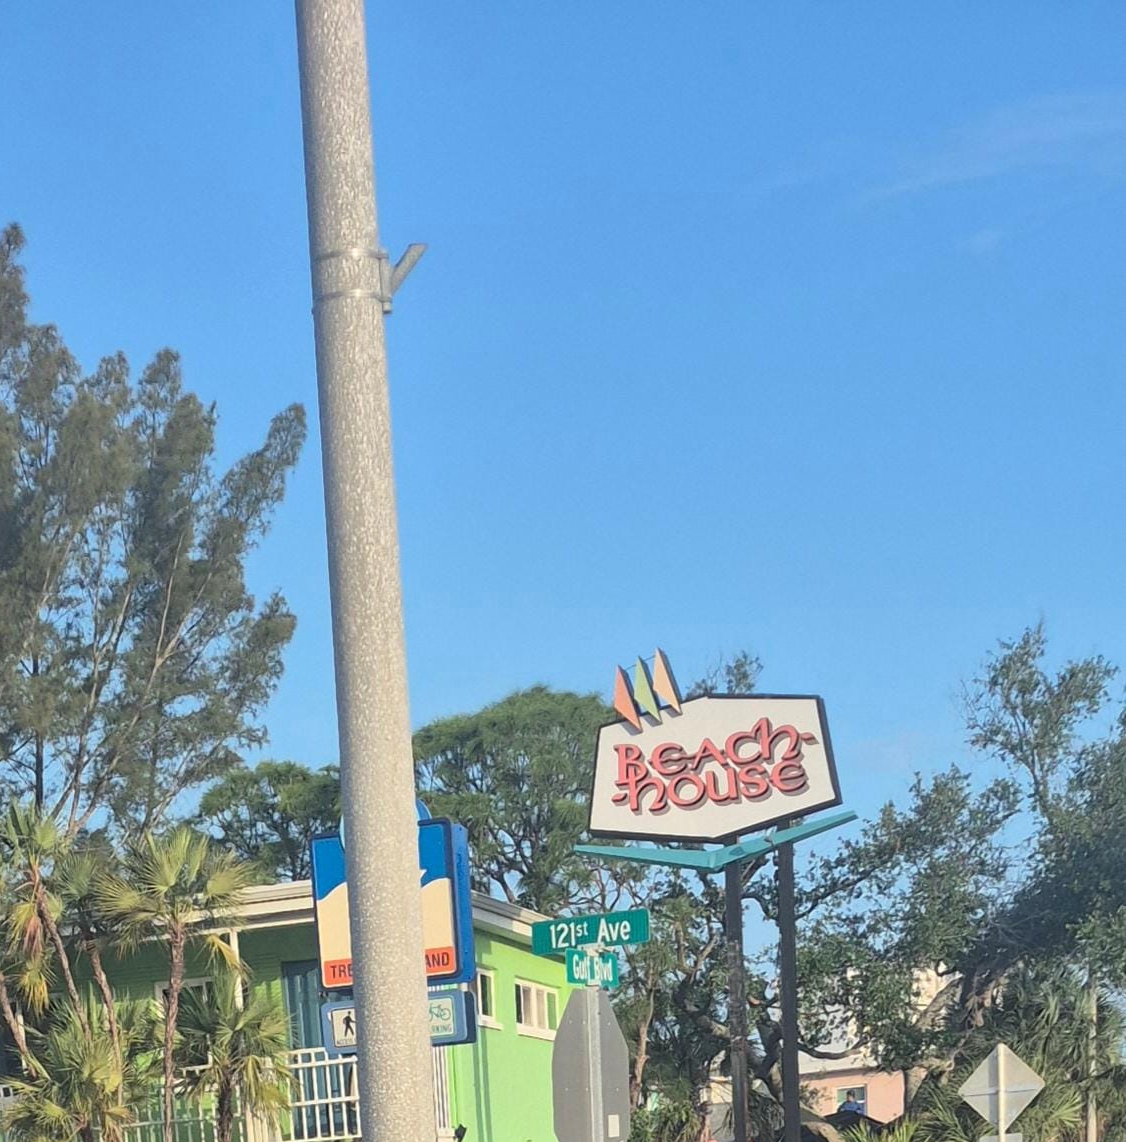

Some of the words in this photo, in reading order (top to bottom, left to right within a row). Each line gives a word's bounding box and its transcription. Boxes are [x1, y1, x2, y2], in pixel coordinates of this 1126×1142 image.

[613, 716, 818, 787] BEACH
[611, 759, 808, 813] HOUSE
[550, 920, 588, 949] 121st
[597, 918, 631, 943] Ave
[330, 963, 353, 980] TRE
[425, 951, 450, 968] AND
[572, 954, 590, 980] Gulf
[594, 956, 613, 982] Blvd
